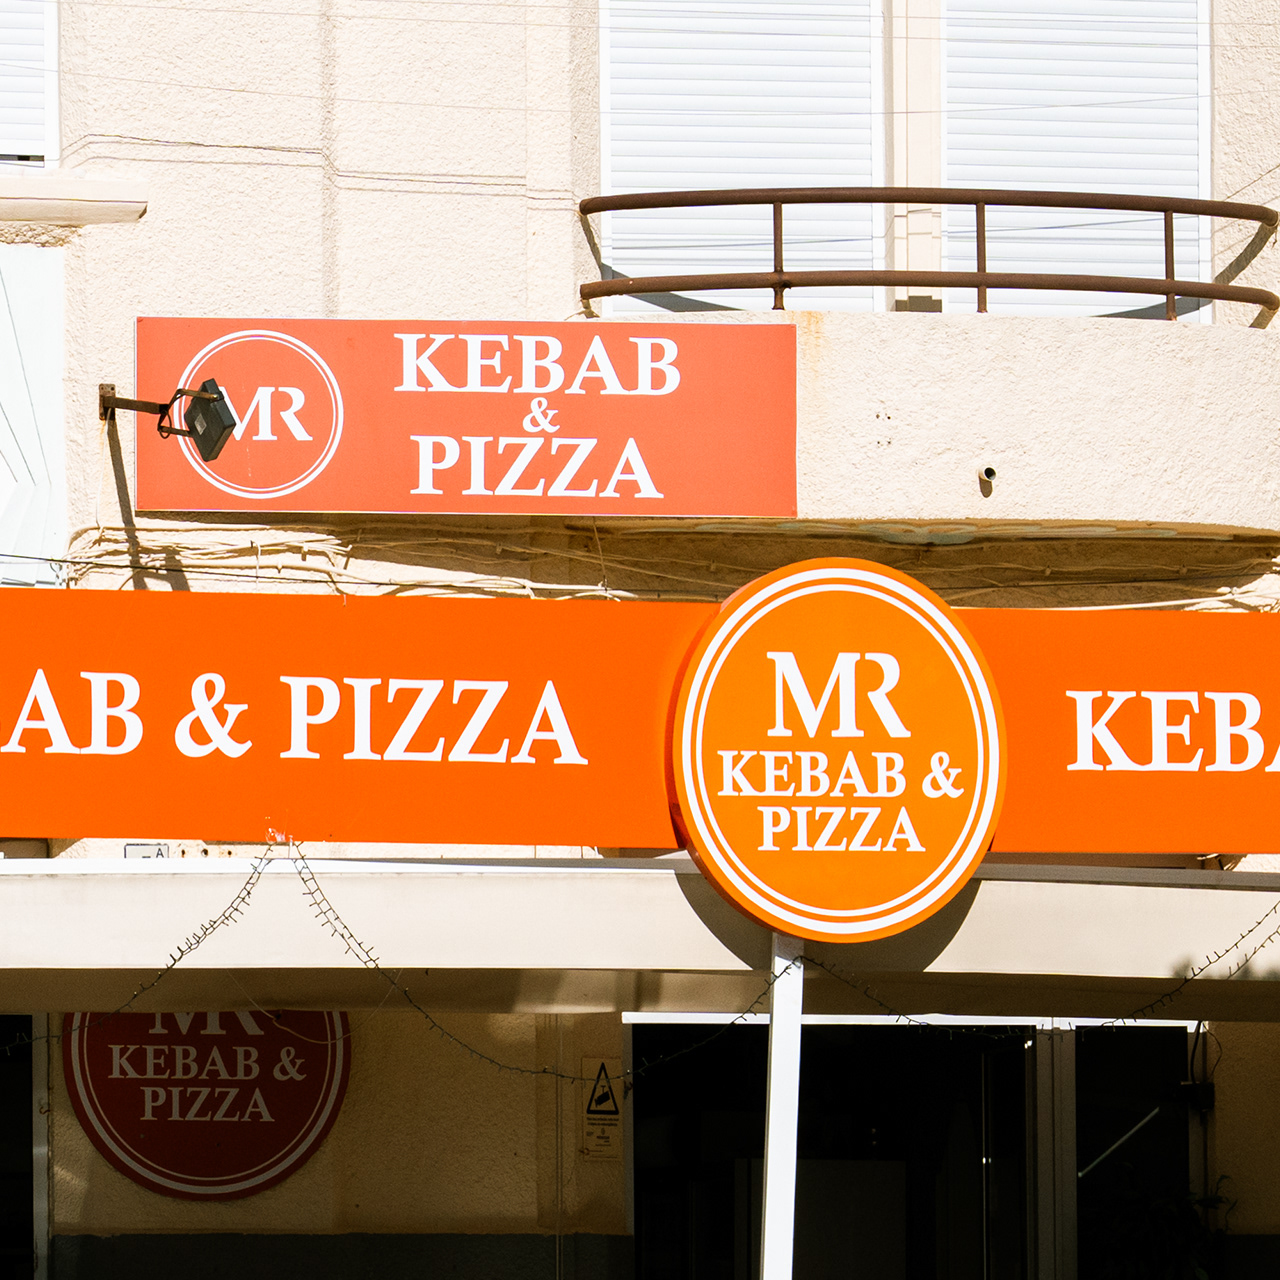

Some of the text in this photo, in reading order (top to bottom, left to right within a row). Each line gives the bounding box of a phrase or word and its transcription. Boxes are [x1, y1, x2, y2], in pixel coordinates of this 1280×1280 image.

[393, 333, 681, 395] KEBAB
[219, 386, 313, 441] MR
[522, 397, 560, 433] &
[410, 434, 664, 499] PIZZA
[174, 672, 252, 758] &
[279, 675, 589, 765] PIZZA
[766, 651, 912, 738] MR
[717, 750, 965, 799] KEBAB &
[757, 806, 926, 852] PIZZA
[108, 1044, 307, 1081] KEBAB &
[140, 1086, 275, 1122] PIZZA
